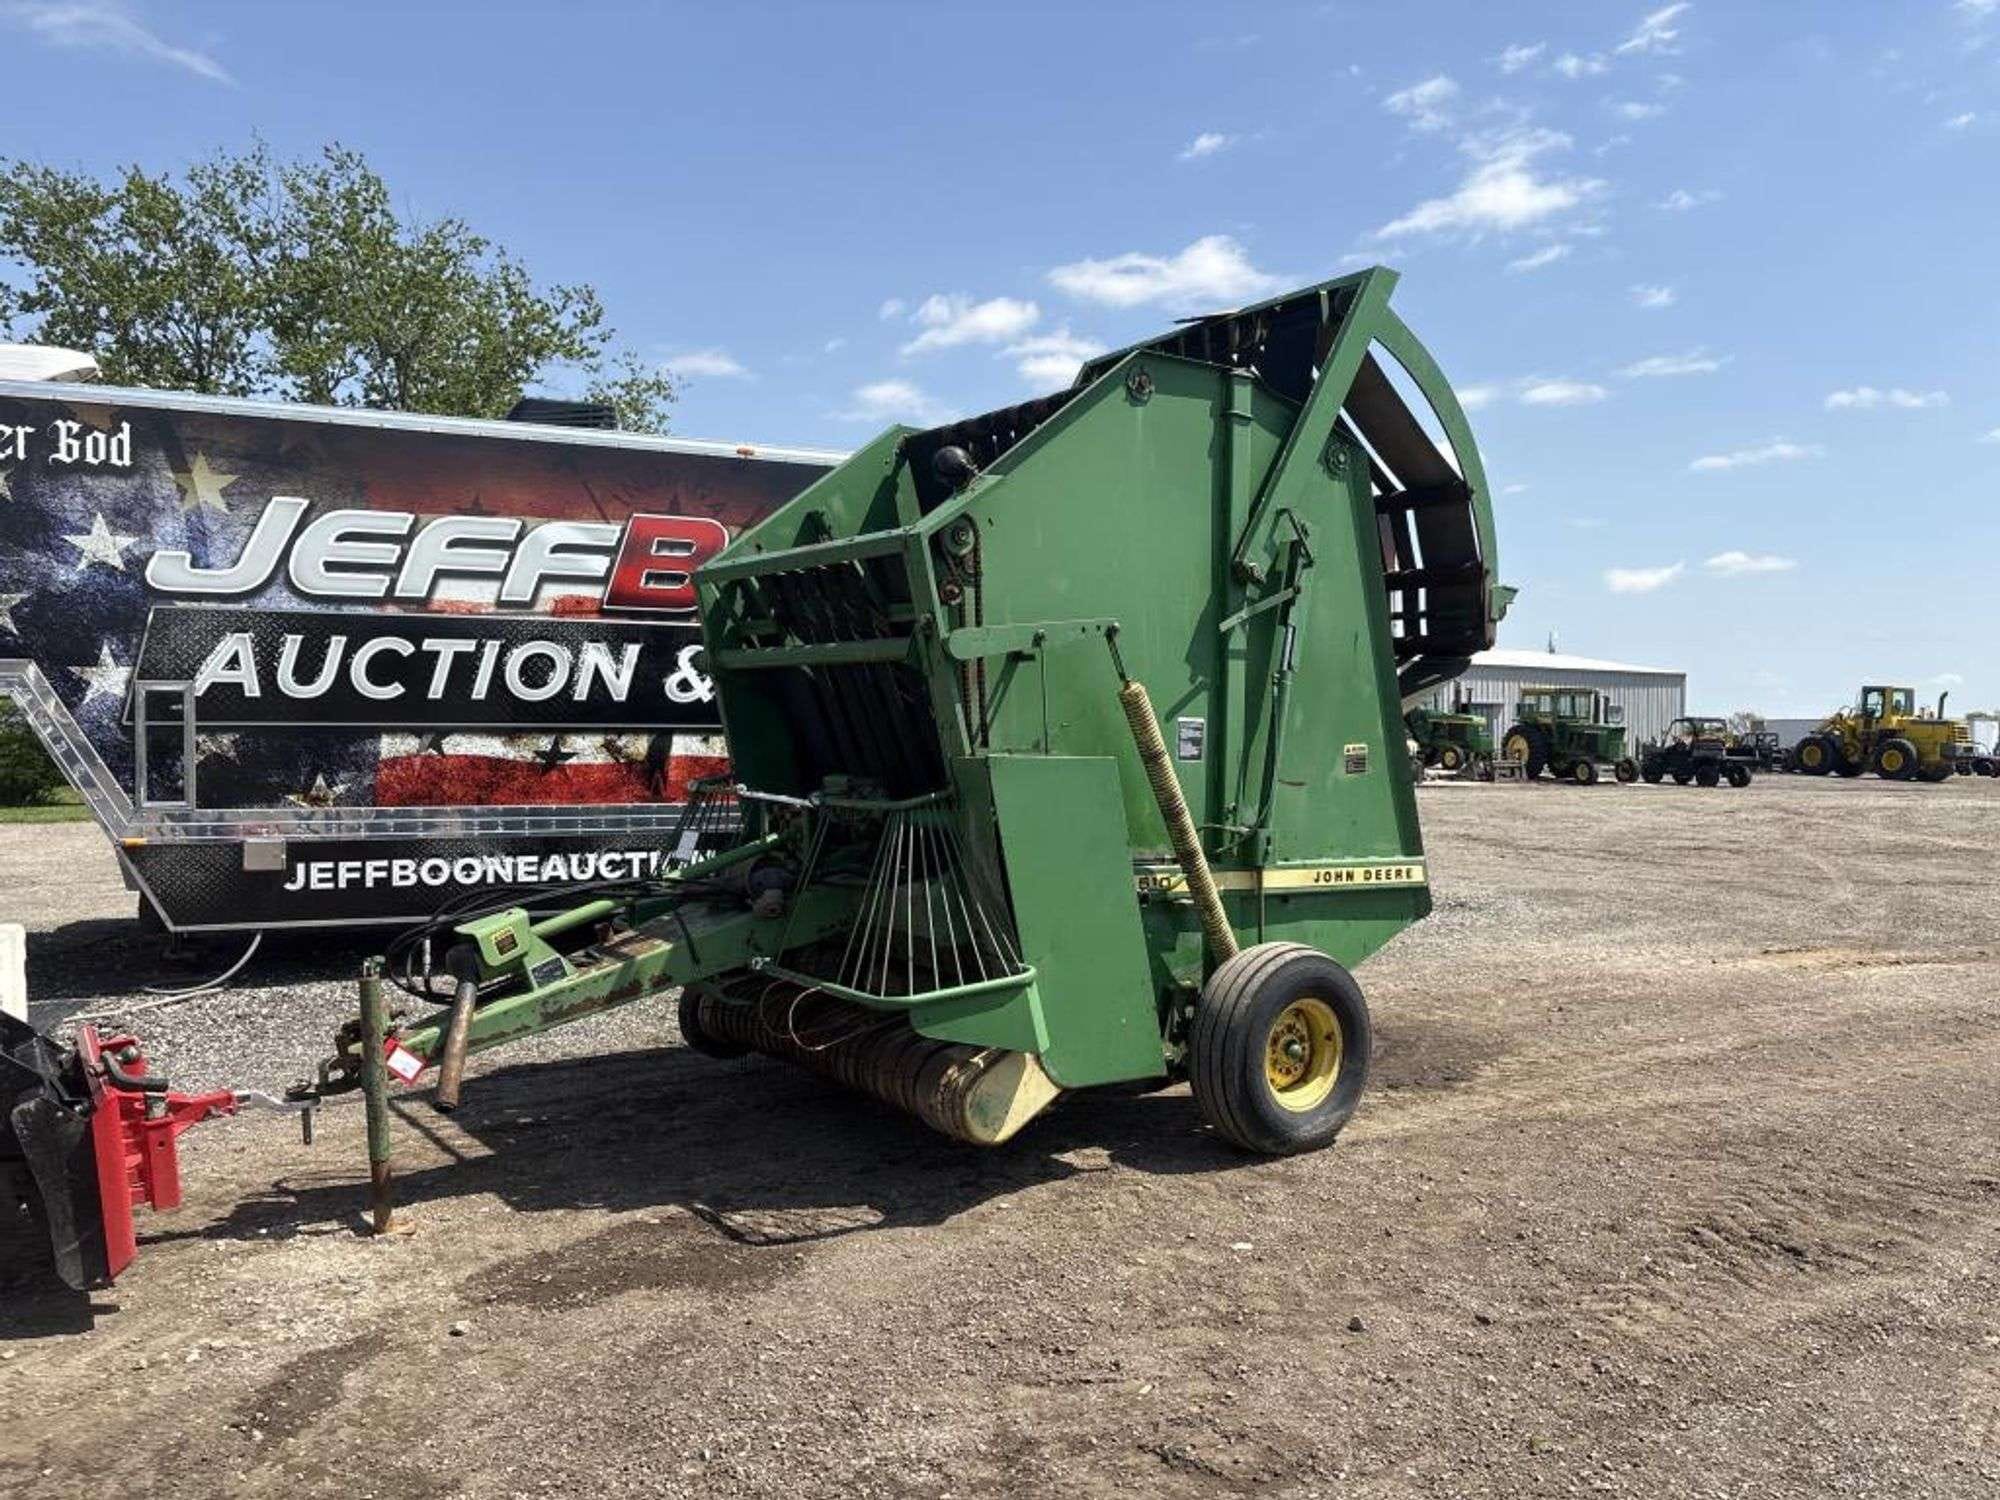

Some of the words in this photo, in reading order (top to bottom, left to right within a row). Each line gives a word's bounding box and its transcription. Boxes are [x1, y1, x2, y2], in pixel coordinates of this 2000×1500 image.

[196, 633, 640, 702] AUCTION
[665, 646, 715, 703] &
[1314, 871, 1354, 883] JOHN
[1363, 867, 1413, 881] DEERE
